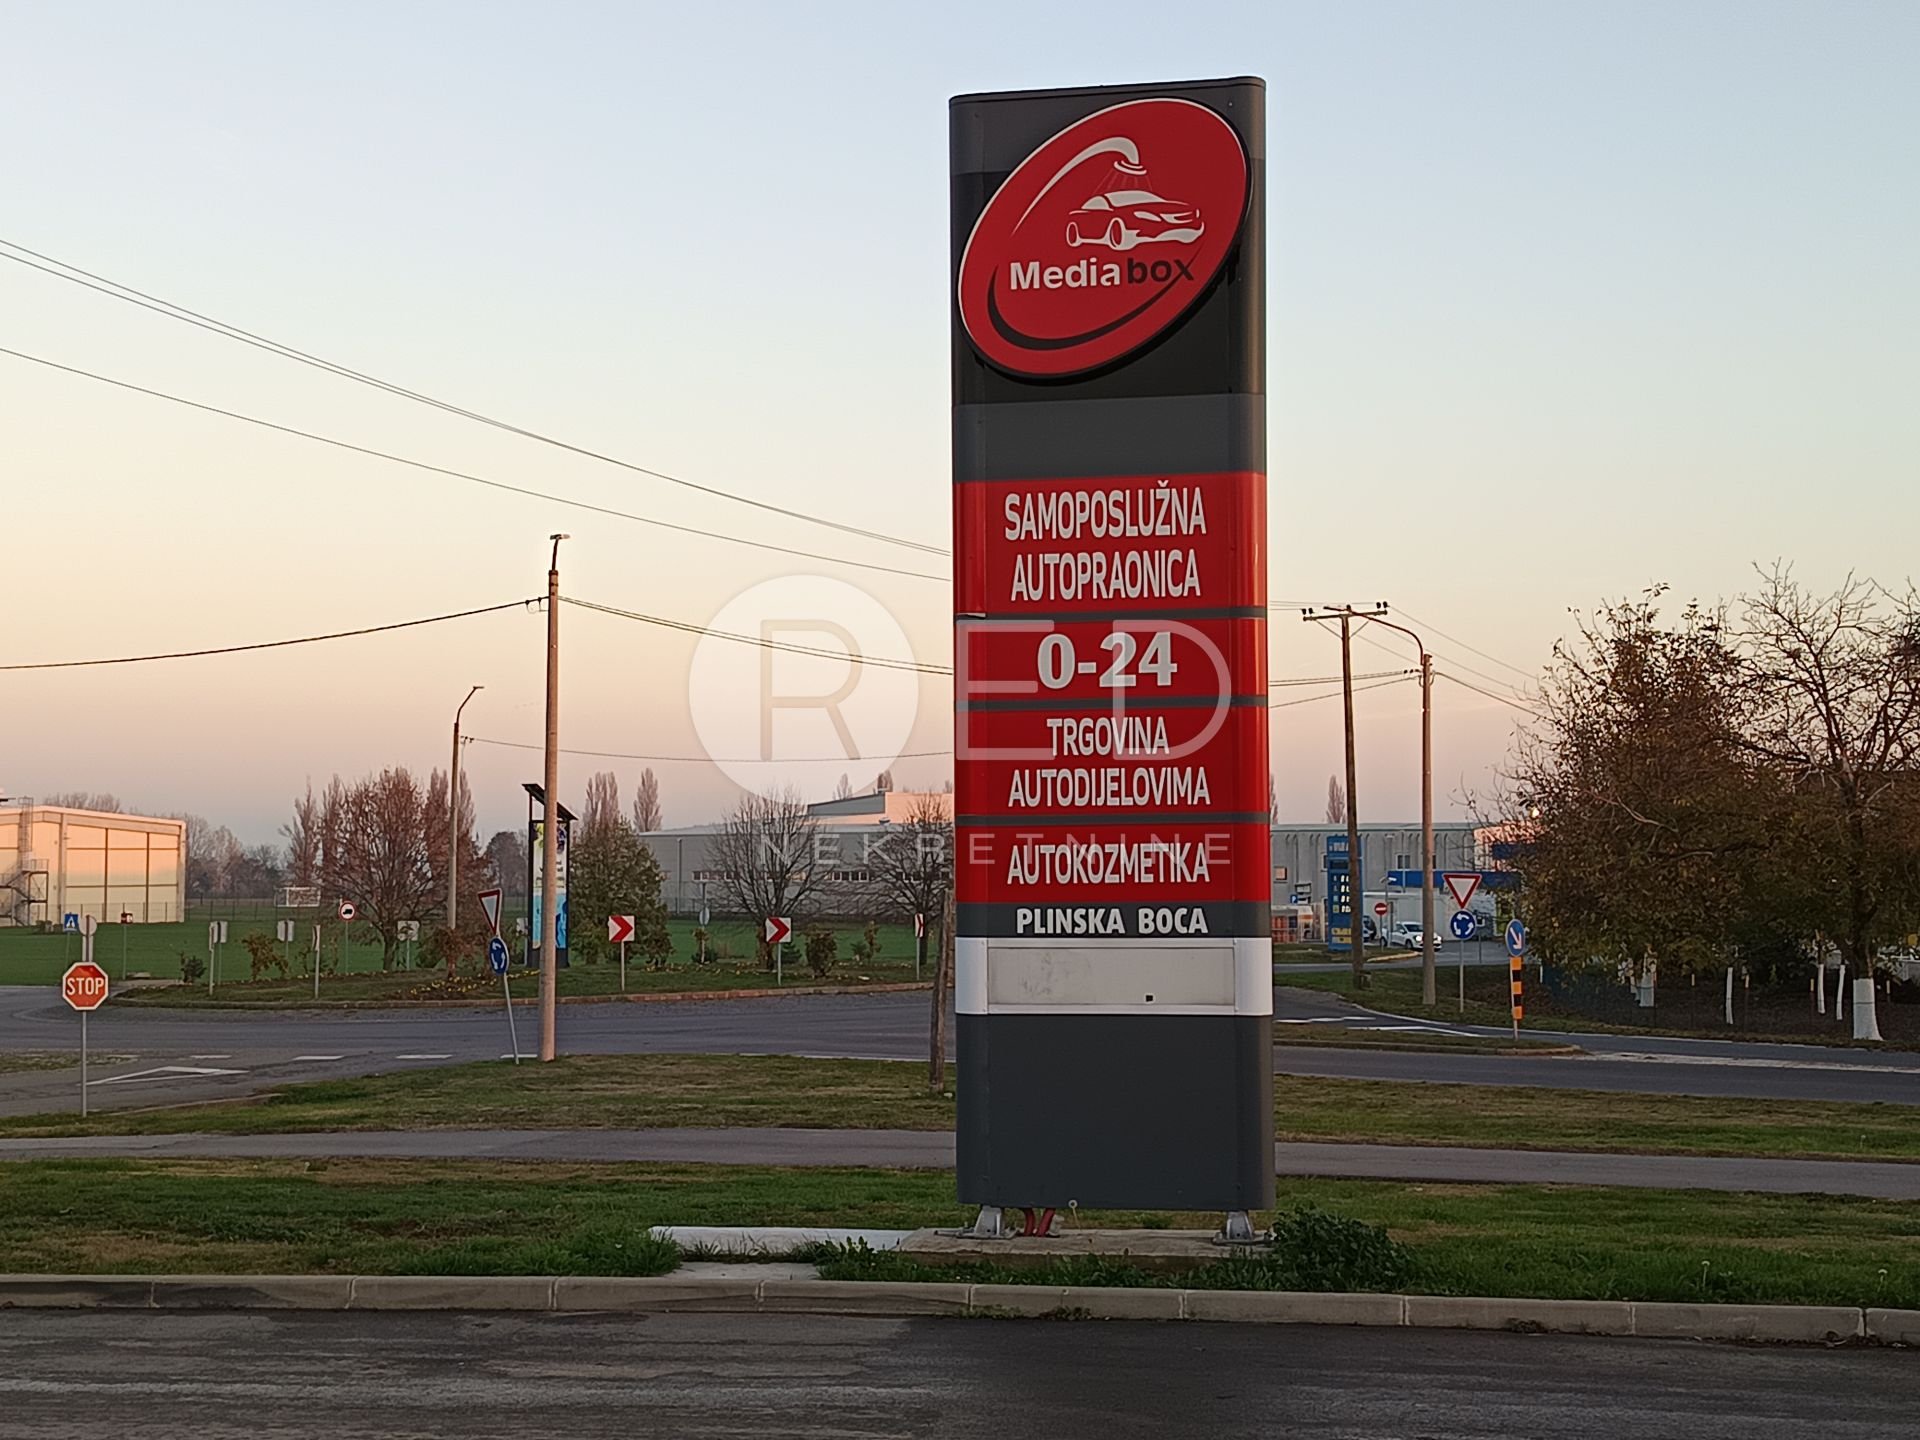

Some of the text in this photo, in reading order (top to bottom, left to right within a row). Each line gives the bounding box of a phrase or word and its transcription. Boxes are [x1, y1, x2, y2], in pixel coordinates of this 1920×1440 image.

[1004, 480, 1207, 541] SAMOPOSLUŽNA
[1011, 549, 1201, 601] AUTOPRAONICA
[1037, 631, 1178, 689] 0-24
[1046, 716, 1170, 756] TRGOVINA
[1008, 767, 1211, 807] AUTODIJELOVIMA
[1007, 842, 1210, 884] AUTOKOZMETIKA
[1016, 907, 1208, 934] PLINSKA BOCA
[66, 977, 105, 996] STOP
